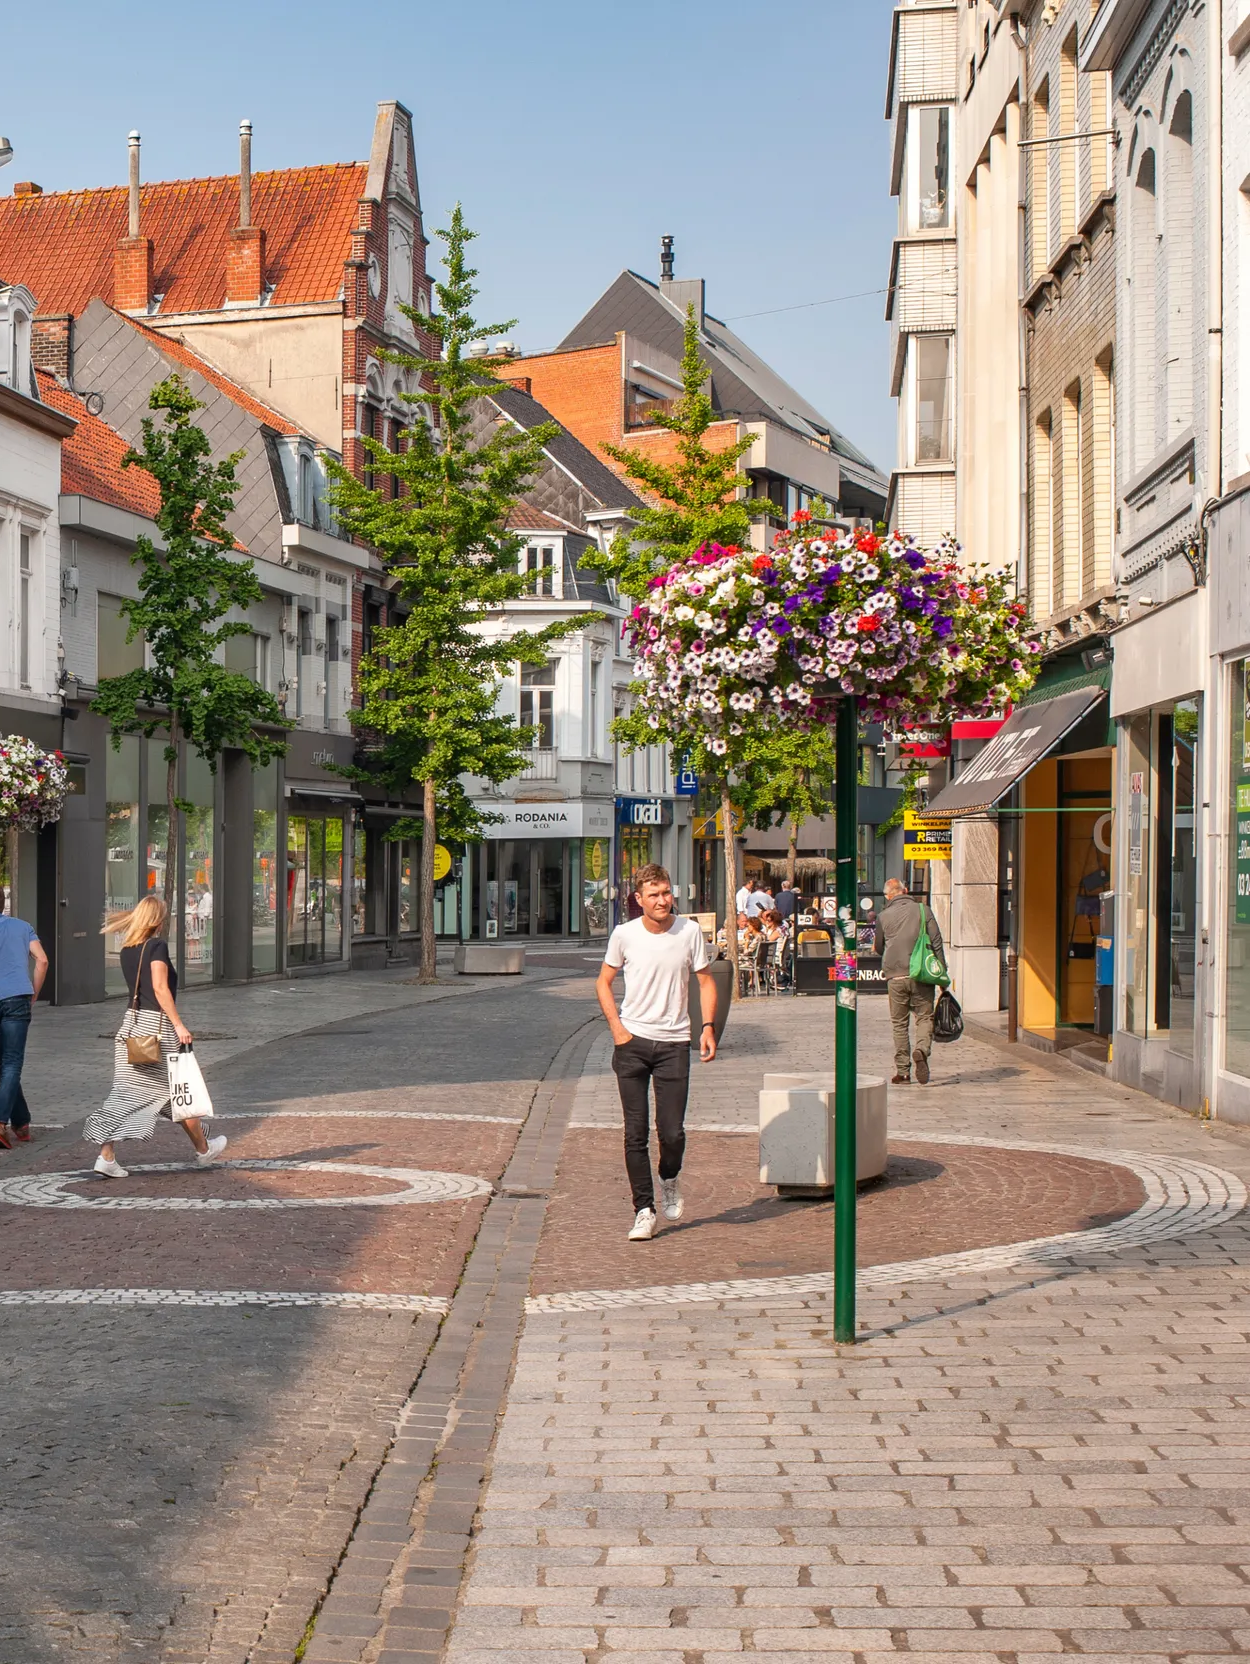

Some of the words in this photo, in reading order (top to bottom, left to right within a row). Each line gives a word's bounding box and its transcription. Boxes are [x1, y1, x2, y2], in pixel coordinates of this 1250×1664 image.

[954, 726, 1042, 786] OUTLET
[515, 813, 568, 822] RODANIA
[1237, 874, 1245, 895] 03
